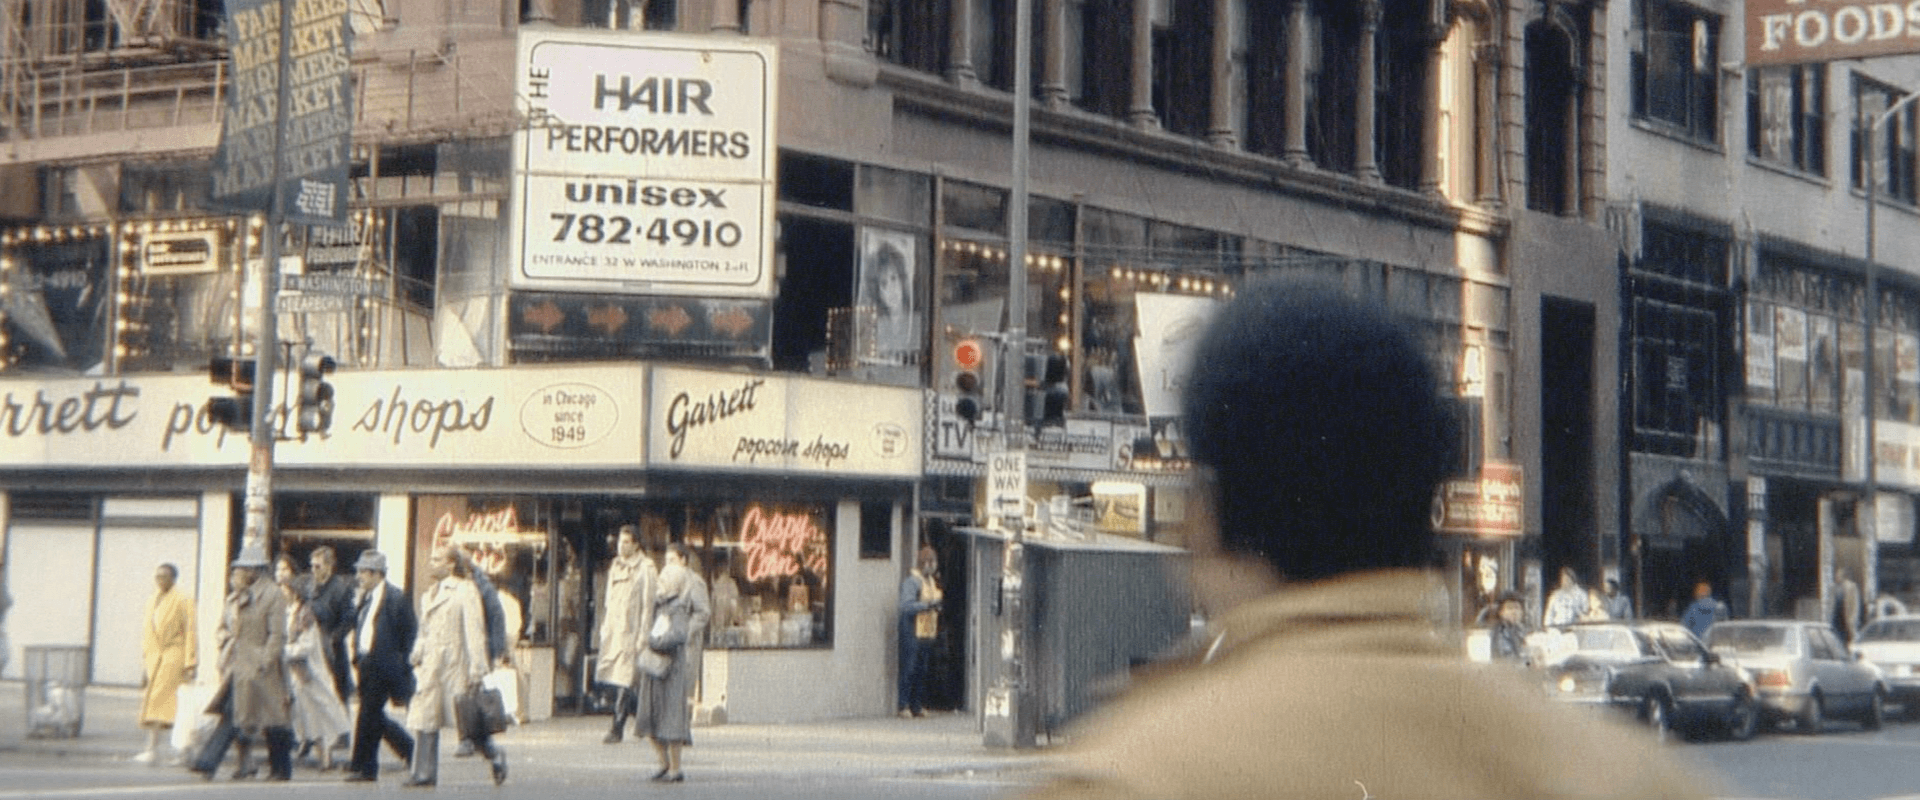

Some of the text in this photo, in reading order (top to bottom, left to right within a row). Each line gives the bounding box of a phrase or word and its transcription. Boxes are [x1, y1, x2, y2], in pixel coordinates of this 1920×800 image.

[1759, 1, 1920, 51] FOODS
[594, 73, 714, 116] HAIR
[548, 124, 750, 159] PERFORMERS
[565, 178, 727, 209] unisex
[532, 254, 597, 267] ENTRANCE
[604, 256, 618, 267] 32
[623, 257, 635, 268] W
[640, 259, 719, 272] WASHINGTON
[555, 389, 597, 408] Chicago
[354, 386, 494, 448] shops
[554, 410, 585, 423] since
[667, 379, 765, 459] Garrett
[551, 425, 586, 442] 1949
[942, 421, 970, 449] TV
[732, 437, 799, 462] popcorn
[802, 434, 850, 466] shops
[994, 456, 1020, 472] ONE
[994, 474, 1020, 491] WAY
[740, 505, 811, 554] Crispy
